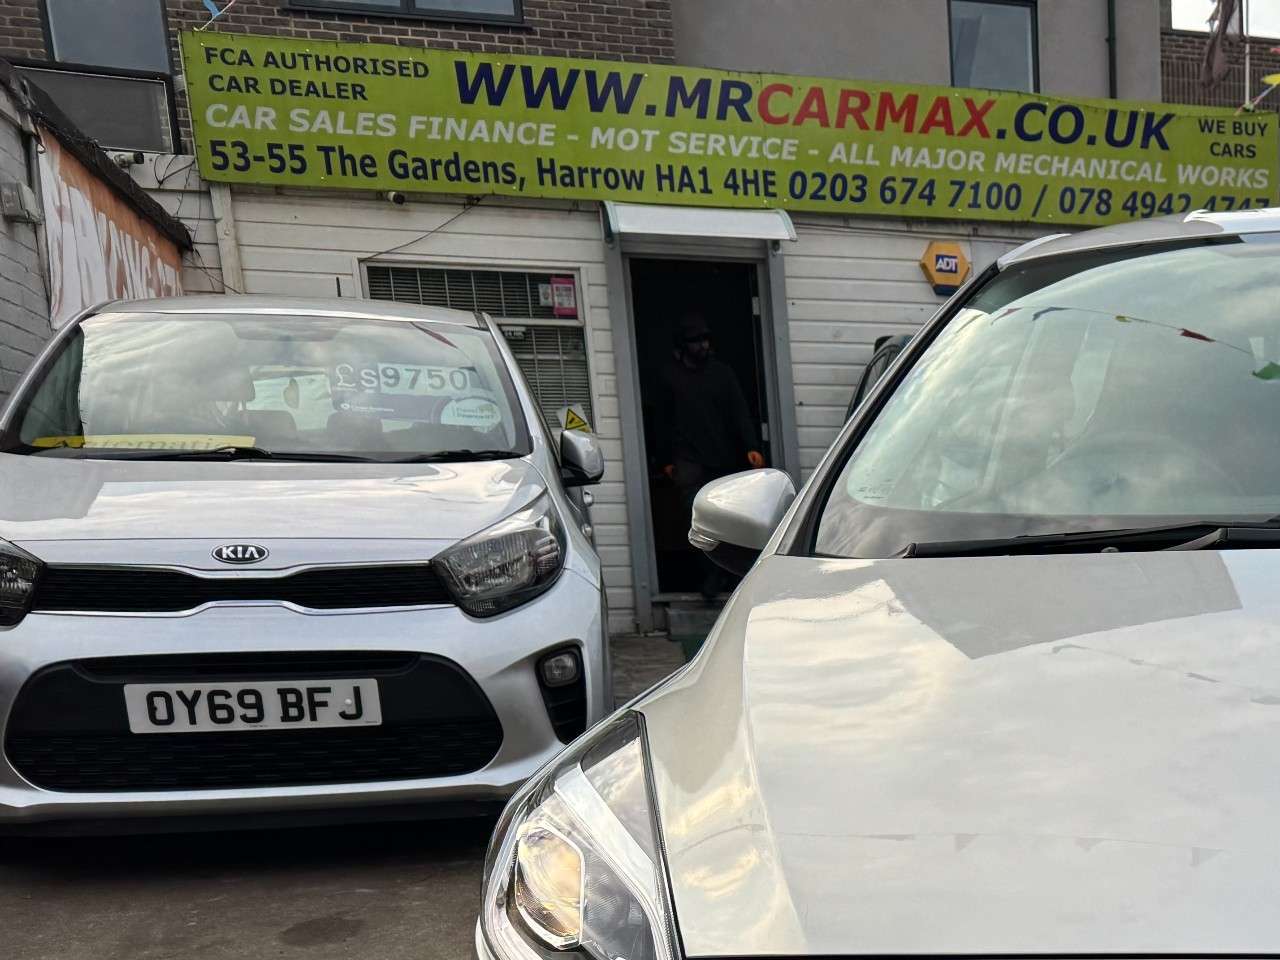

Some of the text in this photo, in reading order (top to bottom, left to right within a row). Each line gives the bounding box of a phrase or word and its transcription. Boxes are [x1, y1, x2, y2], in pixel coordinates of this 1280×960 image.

[204, 47, 430, 79] FCA AUTHORISED
[208, 74, 368, 101] CAR DEALER
[454, 60, 1176, 151] WWW.MRCARMAX.CO.UK
[1199, 119, 1268, 137] WE BUY
[206, 103, 277, 131] CAR
[289, 108, 397, 137] SALES
[409, 114, 556, 146] FINANCE
[590, 126, 660, 153] MOT
[668, 130, 799, 160] SERVICE
[828, 142, 880, 166] ALL
[890, 145, 985, 172] MAJOR
[995, 151, 1167, 183] MECHANICAL
[1177, 164, 1270, 189] WORKS
[1209, 141, 1257, 158] CARS
[209, 139, 308, 175] 53-55
[316, 144, 378, 177] The
[387, 149, 526, 192] Gardens,
[536, 157, 645, 191] Harrow
[655, 163, 713, 194] HA1
[723, 168, 777, 198] 4HE
[789, 171, 868, 203] 0203
[879, 176, 936, 206] 674
[948, 179, 1022, 211] 7100
[1058, 186, 1112, 216] 078
[1121, 190, 1191, 219] 4942
[936, 257, 958, 271] ADT
[222, 546, 260, 559] KIA
[146, 685, 364, 726] OY69 BFJ
